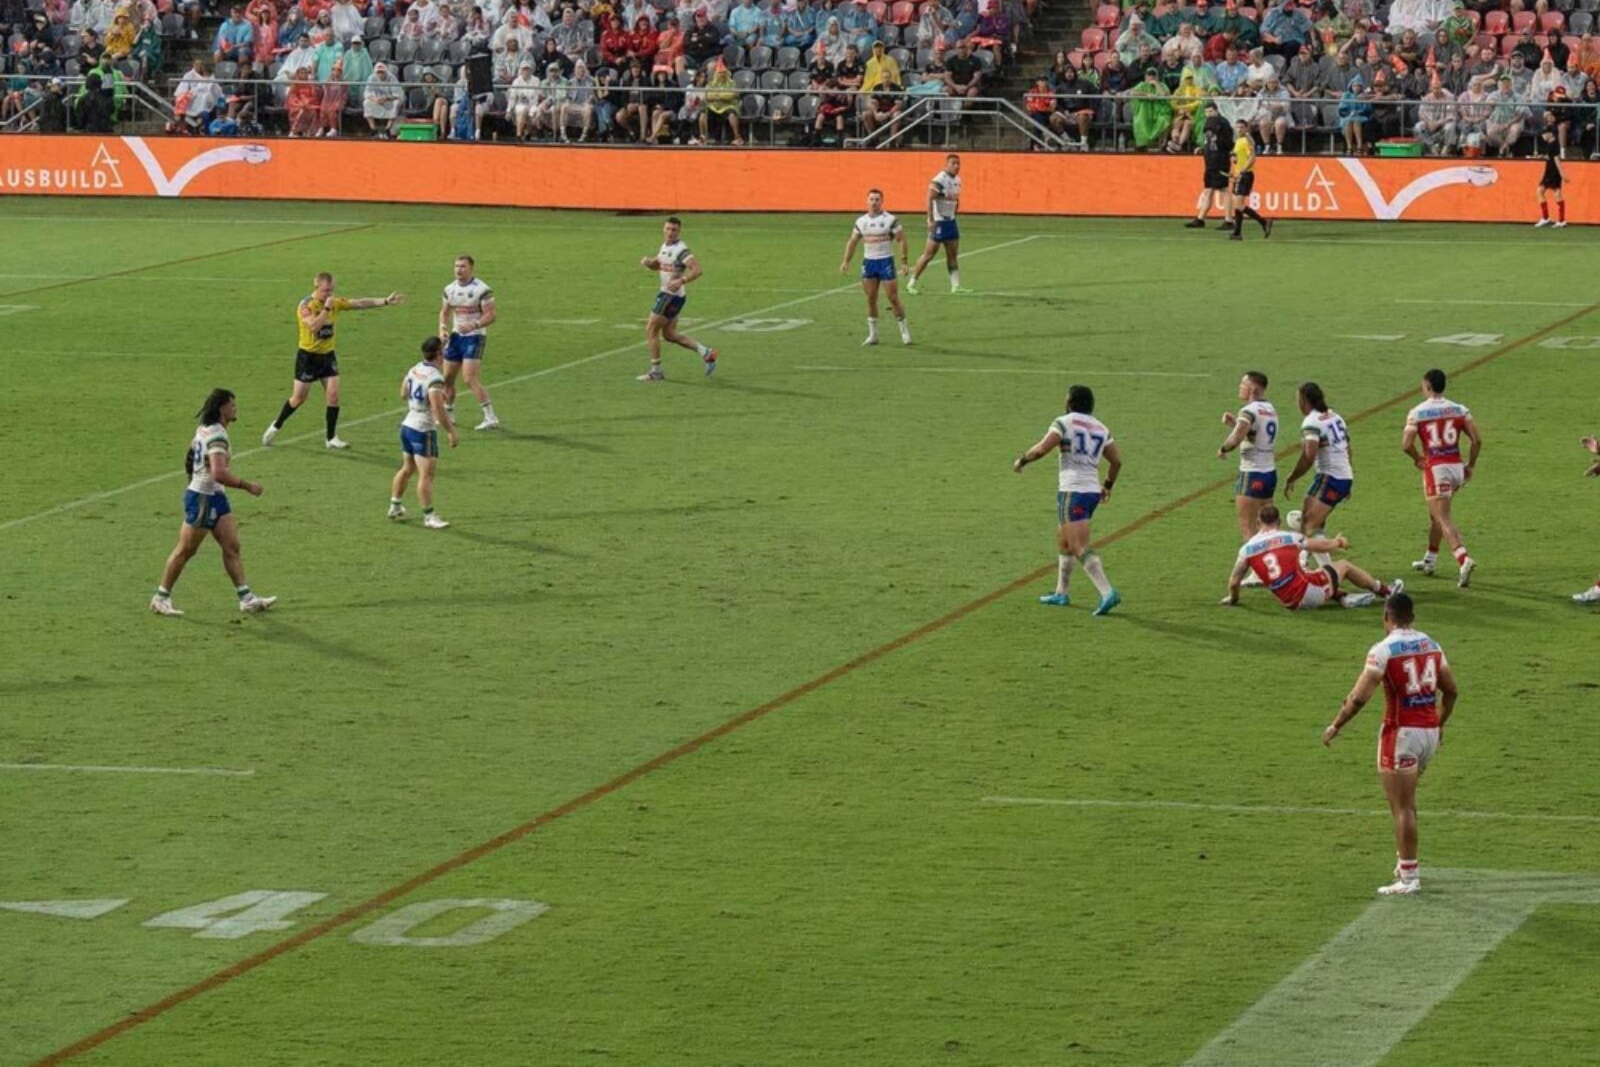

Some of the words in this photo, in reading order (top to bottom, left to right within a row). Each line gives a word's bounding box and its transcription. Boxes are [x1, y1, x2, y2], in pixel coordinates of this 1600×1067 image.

[0, 168, 108, 188] USBUILD
[1074, 431, 1105, 457] 17
[1265, 421, 1277, 445] 9
[1327, 419, 1345, 445] 15
[1425, 419, 1458, 447] 16
[1262, 552, 1282, 581] 3
[1402, 657, 1438, 695] 14
